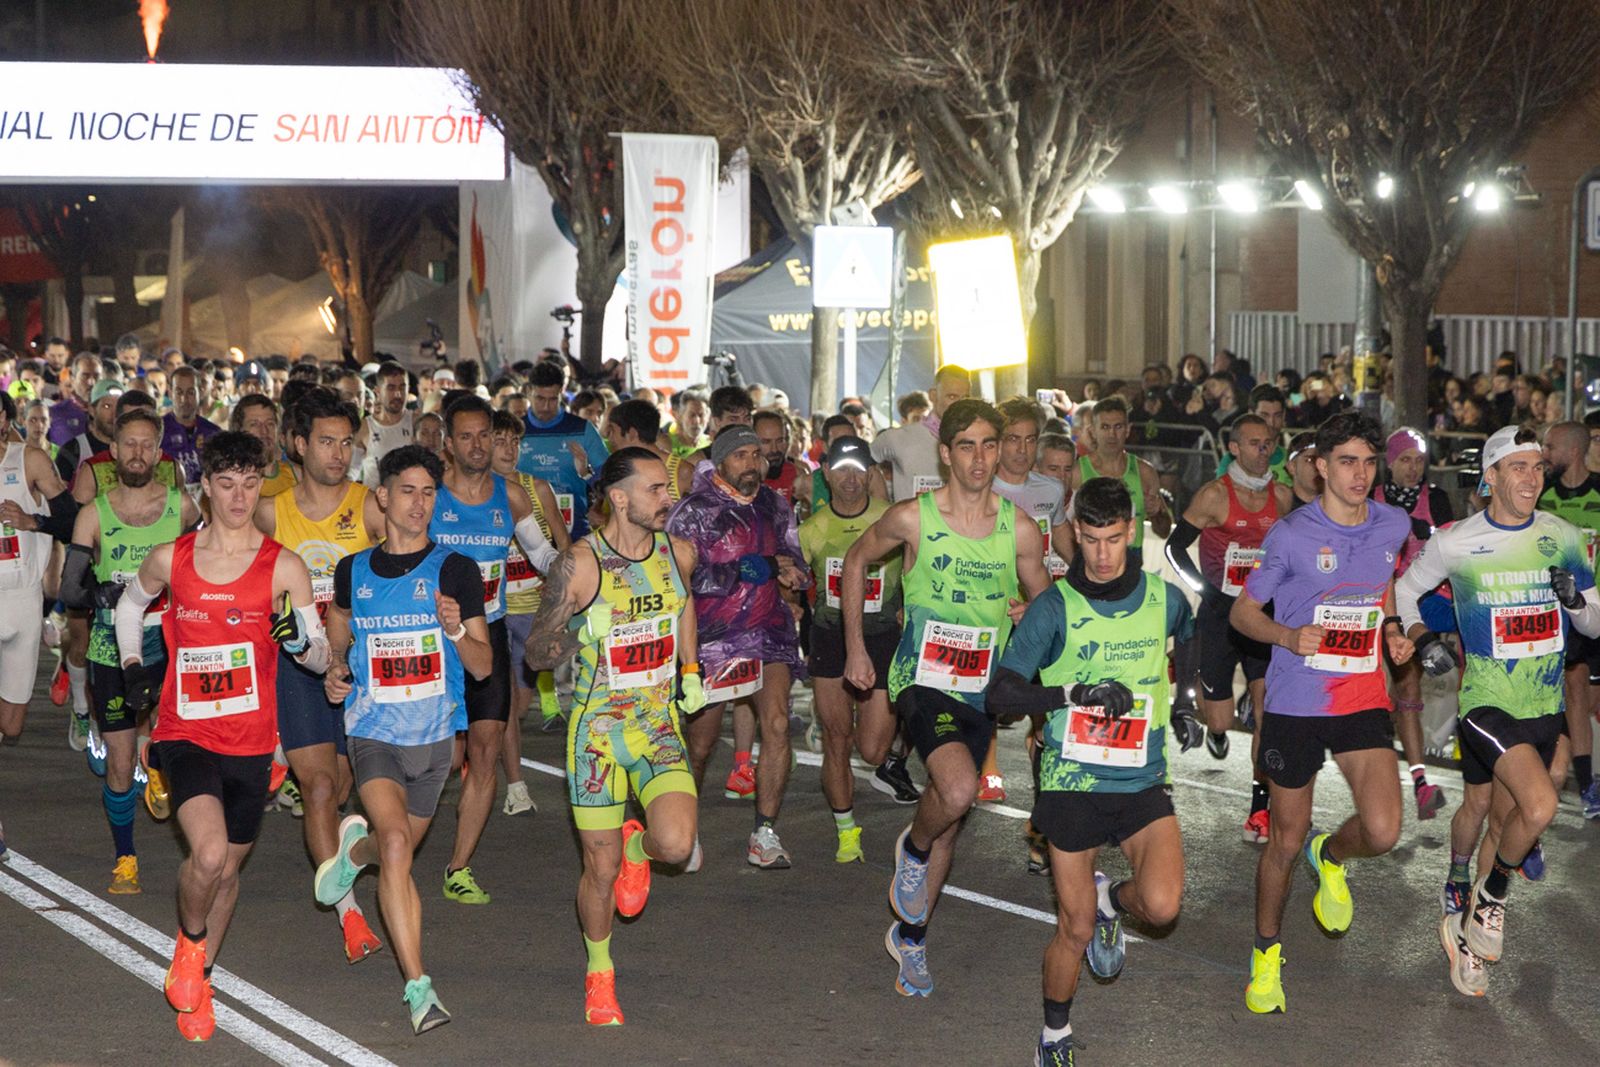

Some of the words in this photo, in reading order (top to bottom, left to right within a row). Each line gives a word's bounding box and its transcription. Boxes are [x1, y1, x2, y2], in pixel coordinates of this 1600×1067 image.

[69, 111, 202, 141] NOCHE
[210, 113, 258, 142] DE
[273, 113, 350, 143] SAN
[357, 105, 485, 144] ANTÓN
[955, 557, 1007, 571] Fundación
[955, 567, 993, 581] Unicaja
[1480, 572, 1494, 587] IV
[1510, 590, 1527, 603] DE
[629, 593, 664, 615] 1153
[1499, 608, 1515, 616] SAN
[1321, 621, 1338, 629] SAN
[1503, 613, 1554, 636] 13491
[930, 635, 947, 645] SAN
[941, 630, 964, 640] NOCHE
[964, 632, 974, 641] DE
[1324, 629, 1370, 651] 8261
[382, 640, 404, 648] NOCHE
[405, 639, 415, 647] DE
[1103, 636, 1160, 651] Fundación
[191, 655, 213, 663] NOCHE
[214, 654, 223, 662] DE
[375, 649, 390, 657] SAN
[624, 639, 665, 666] 2772
[935, 644, 980, 671] 2705
[1103, 649, 1145, 662] Unicaja
[184, 663, 199, 672] SAN
[381, 654, 432, 680] 9949
[199, 671, 234, 694] 321
